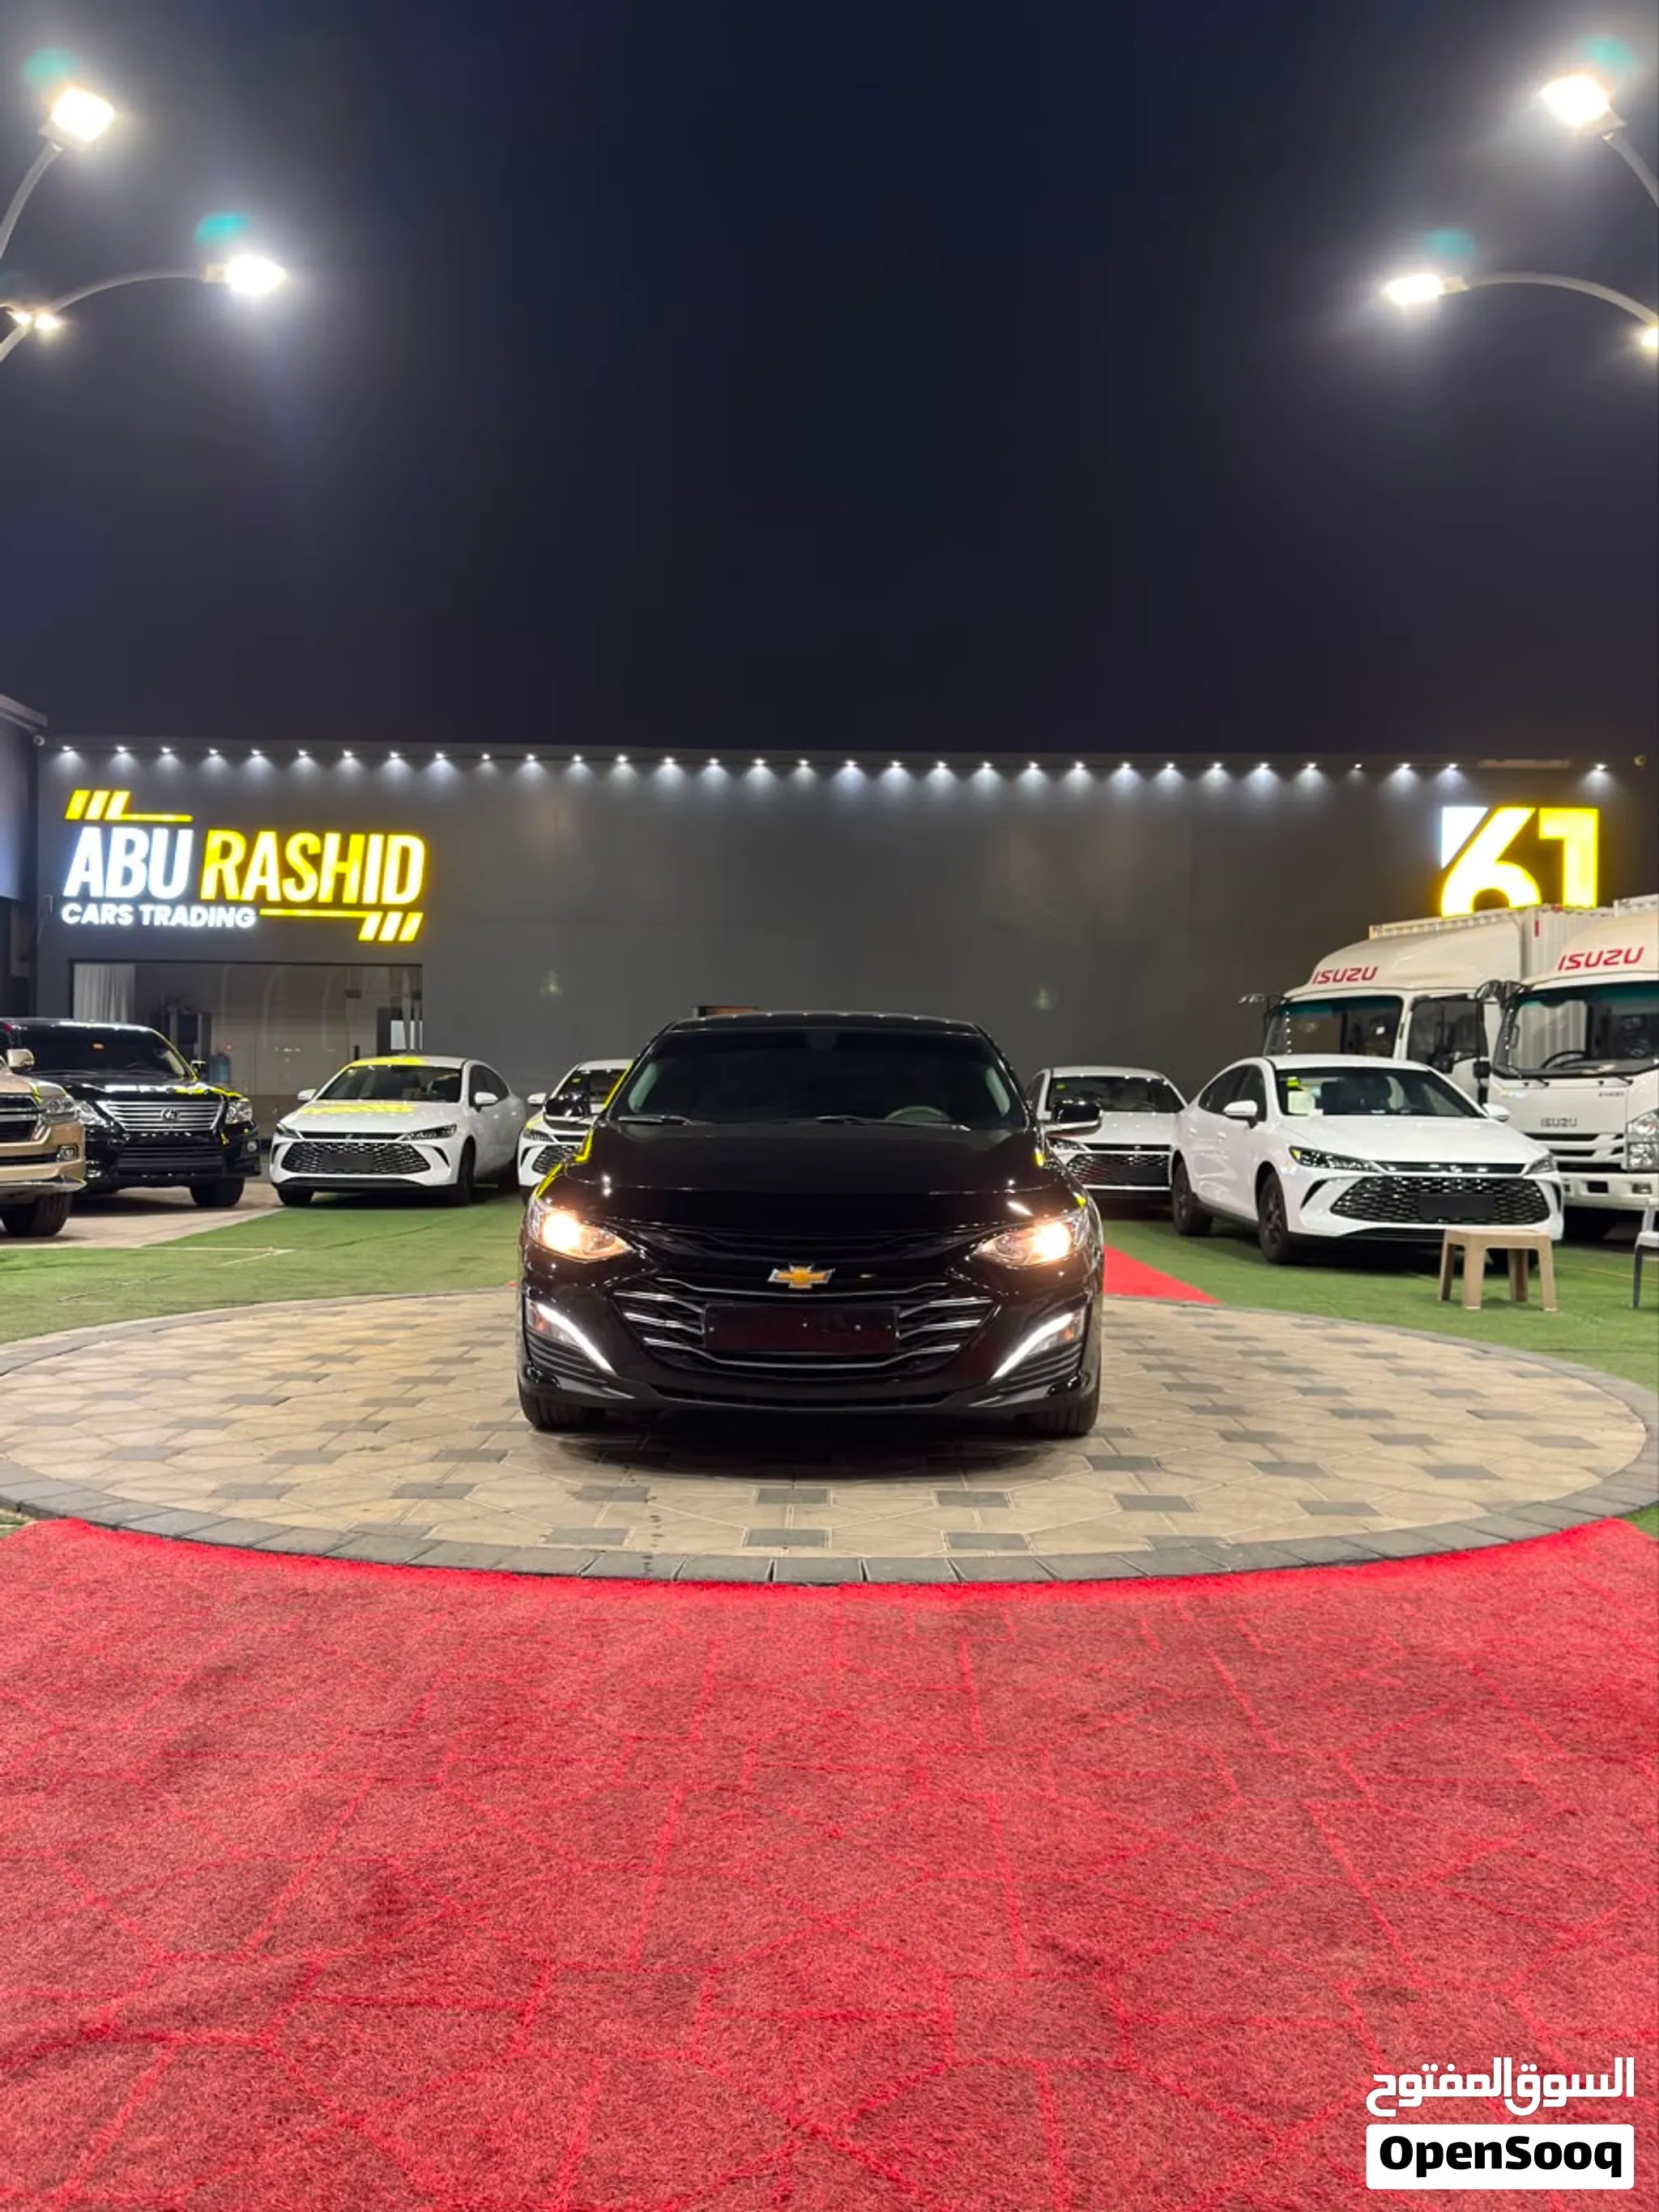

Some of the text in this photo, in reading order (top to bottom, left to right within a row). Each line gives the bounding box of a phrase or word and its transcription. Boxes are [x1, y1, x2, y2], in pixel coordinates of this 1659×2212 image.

[62, 826, 425, 905] ABU RASHID
[62, 902, 257, 928] CARS TRADING
[1557, 946, 1644, 971] ISUZU
[1312, 966, 1379, 984] ISUZU
[1541, 1118, 1577, 1127] ISUZU
